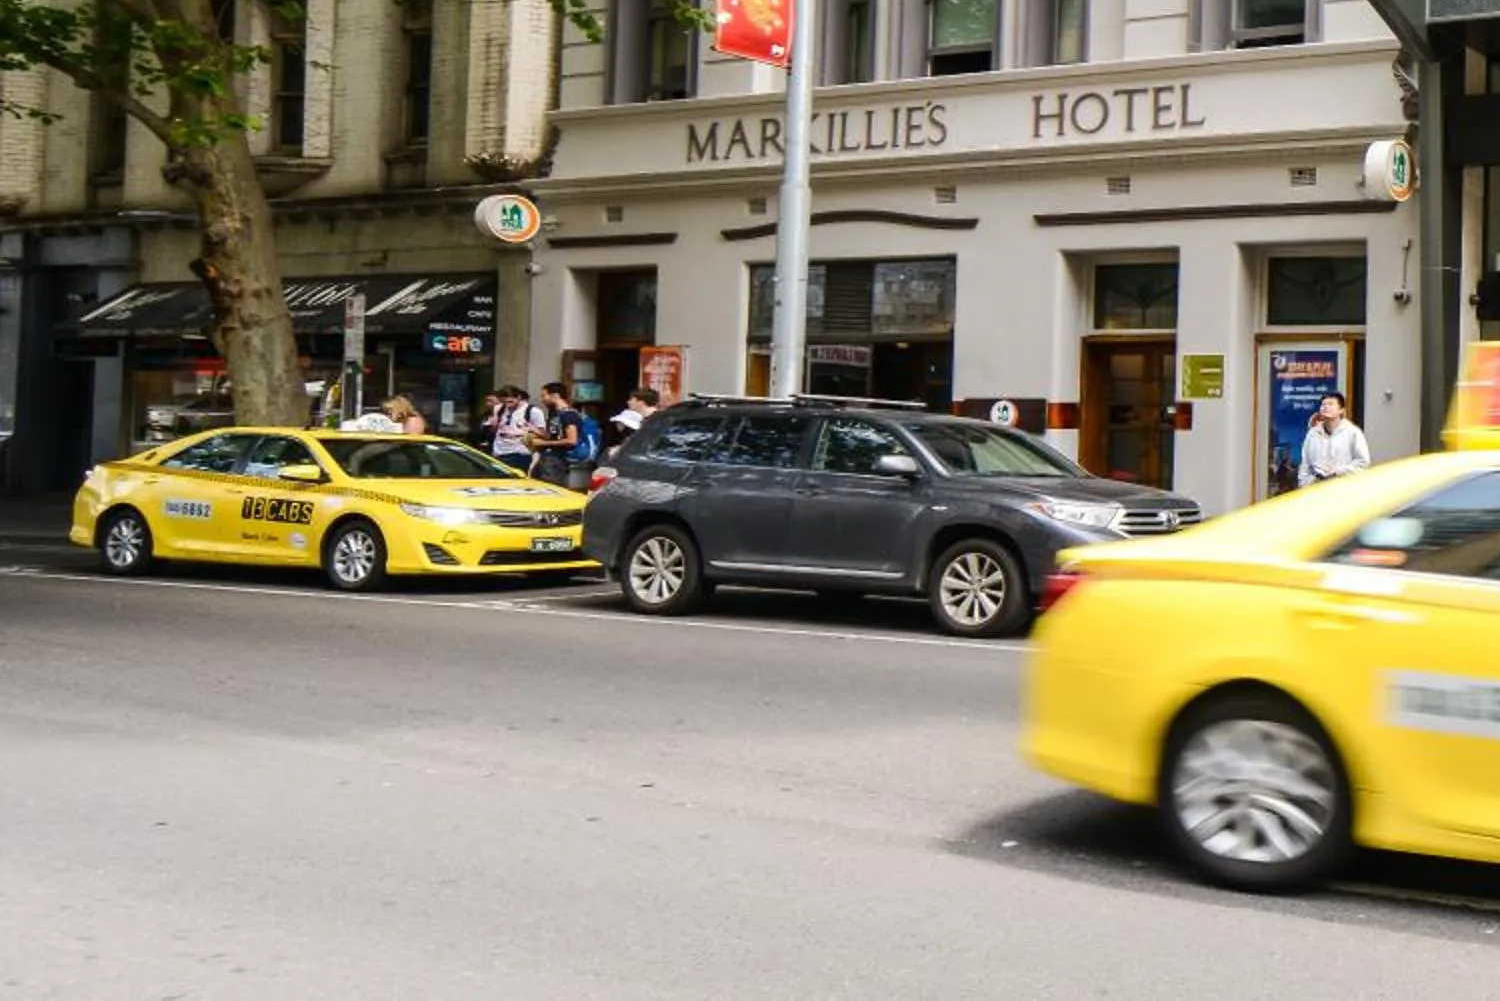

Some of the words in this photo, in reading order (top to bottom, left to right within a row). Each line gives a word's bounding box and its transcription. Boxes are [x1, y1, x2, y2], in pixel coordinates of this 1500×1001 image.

[1033, 84, 1206, 138] HOTEL
[432, 335, 482, 352] cafe
[242, 497, 313, 524] 13CABS
